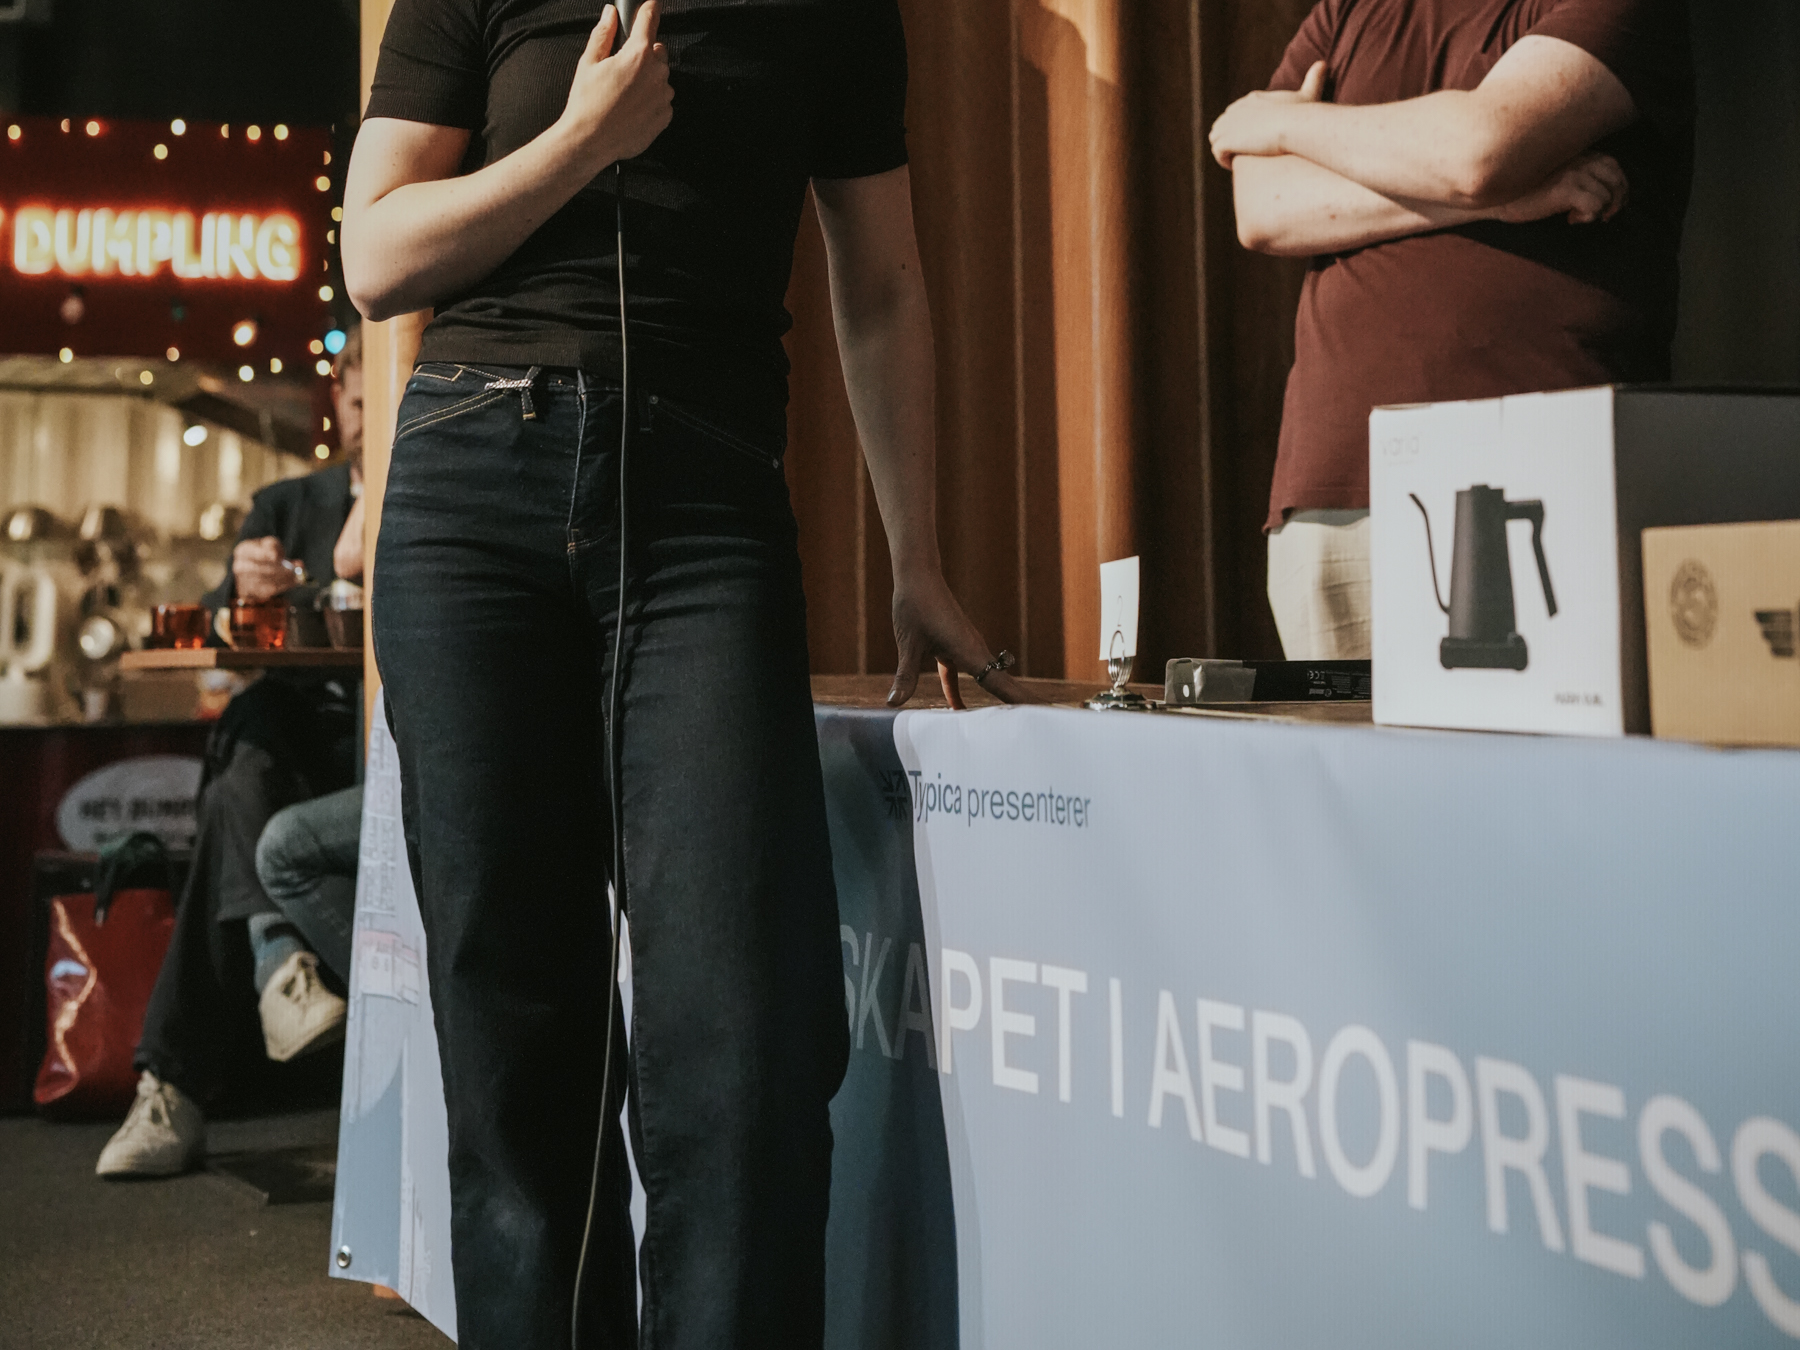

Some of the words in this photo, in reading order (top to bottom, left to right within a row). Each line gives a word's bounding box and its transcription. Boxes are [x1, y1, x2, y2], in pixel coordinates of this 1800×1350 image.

[13, 206, 302, 282] DUMPLING
[907, 770, 962, 823] Typica
[967, 785, 1091, 828] presenterer
[1109, 976, 1124, 1118] I
[1147, 988, 1800, 1341] AEROPRESS
